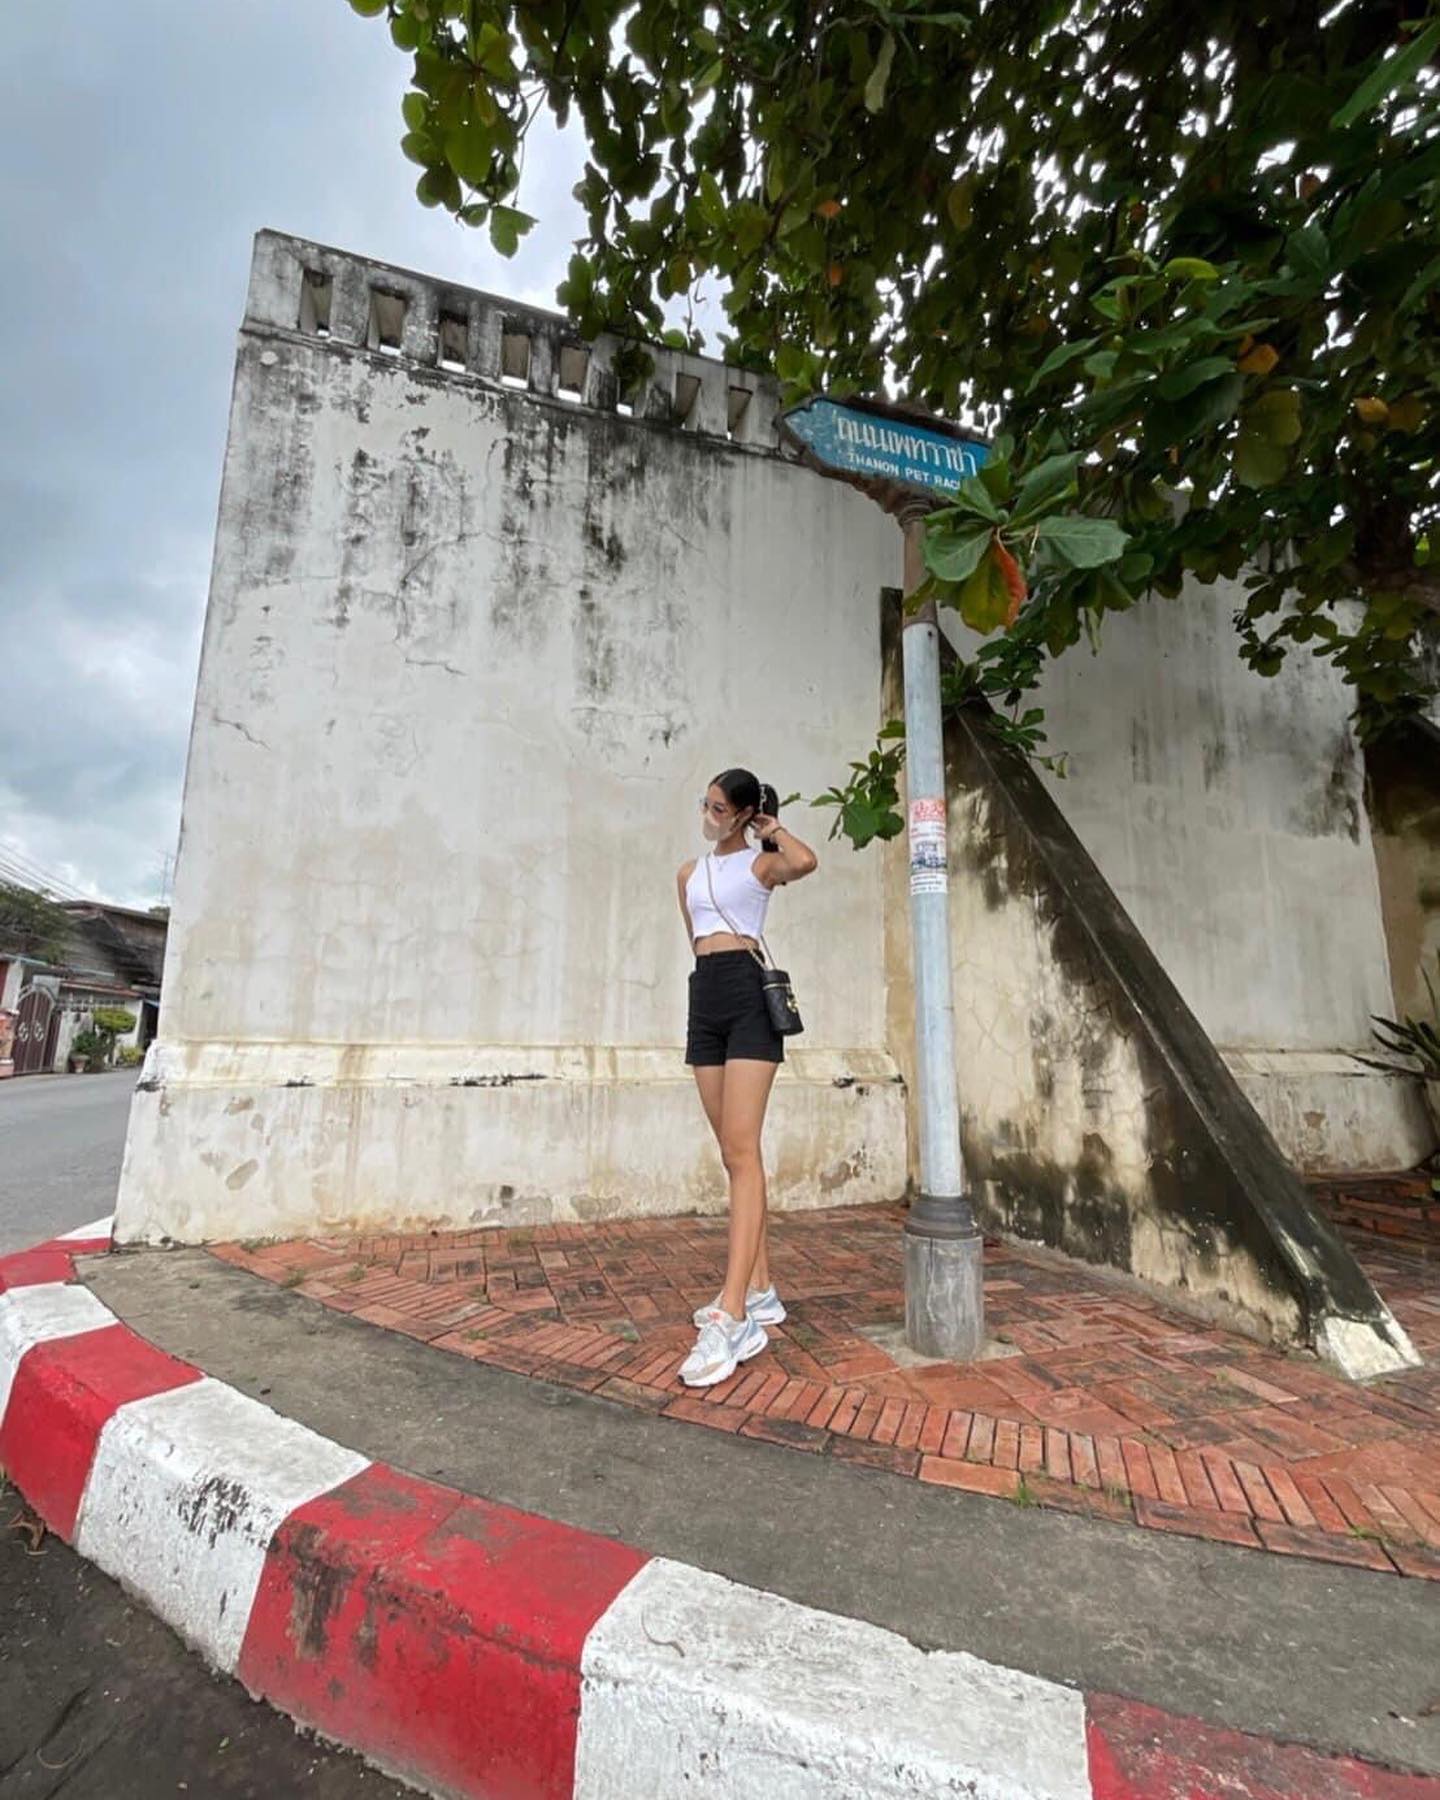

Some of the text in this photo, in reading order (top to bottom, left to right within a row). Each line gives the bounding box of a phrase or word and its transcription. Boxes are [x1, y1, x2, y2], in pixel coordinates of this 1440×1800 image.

[848, 452, 961, 490] THANON PET RAC
